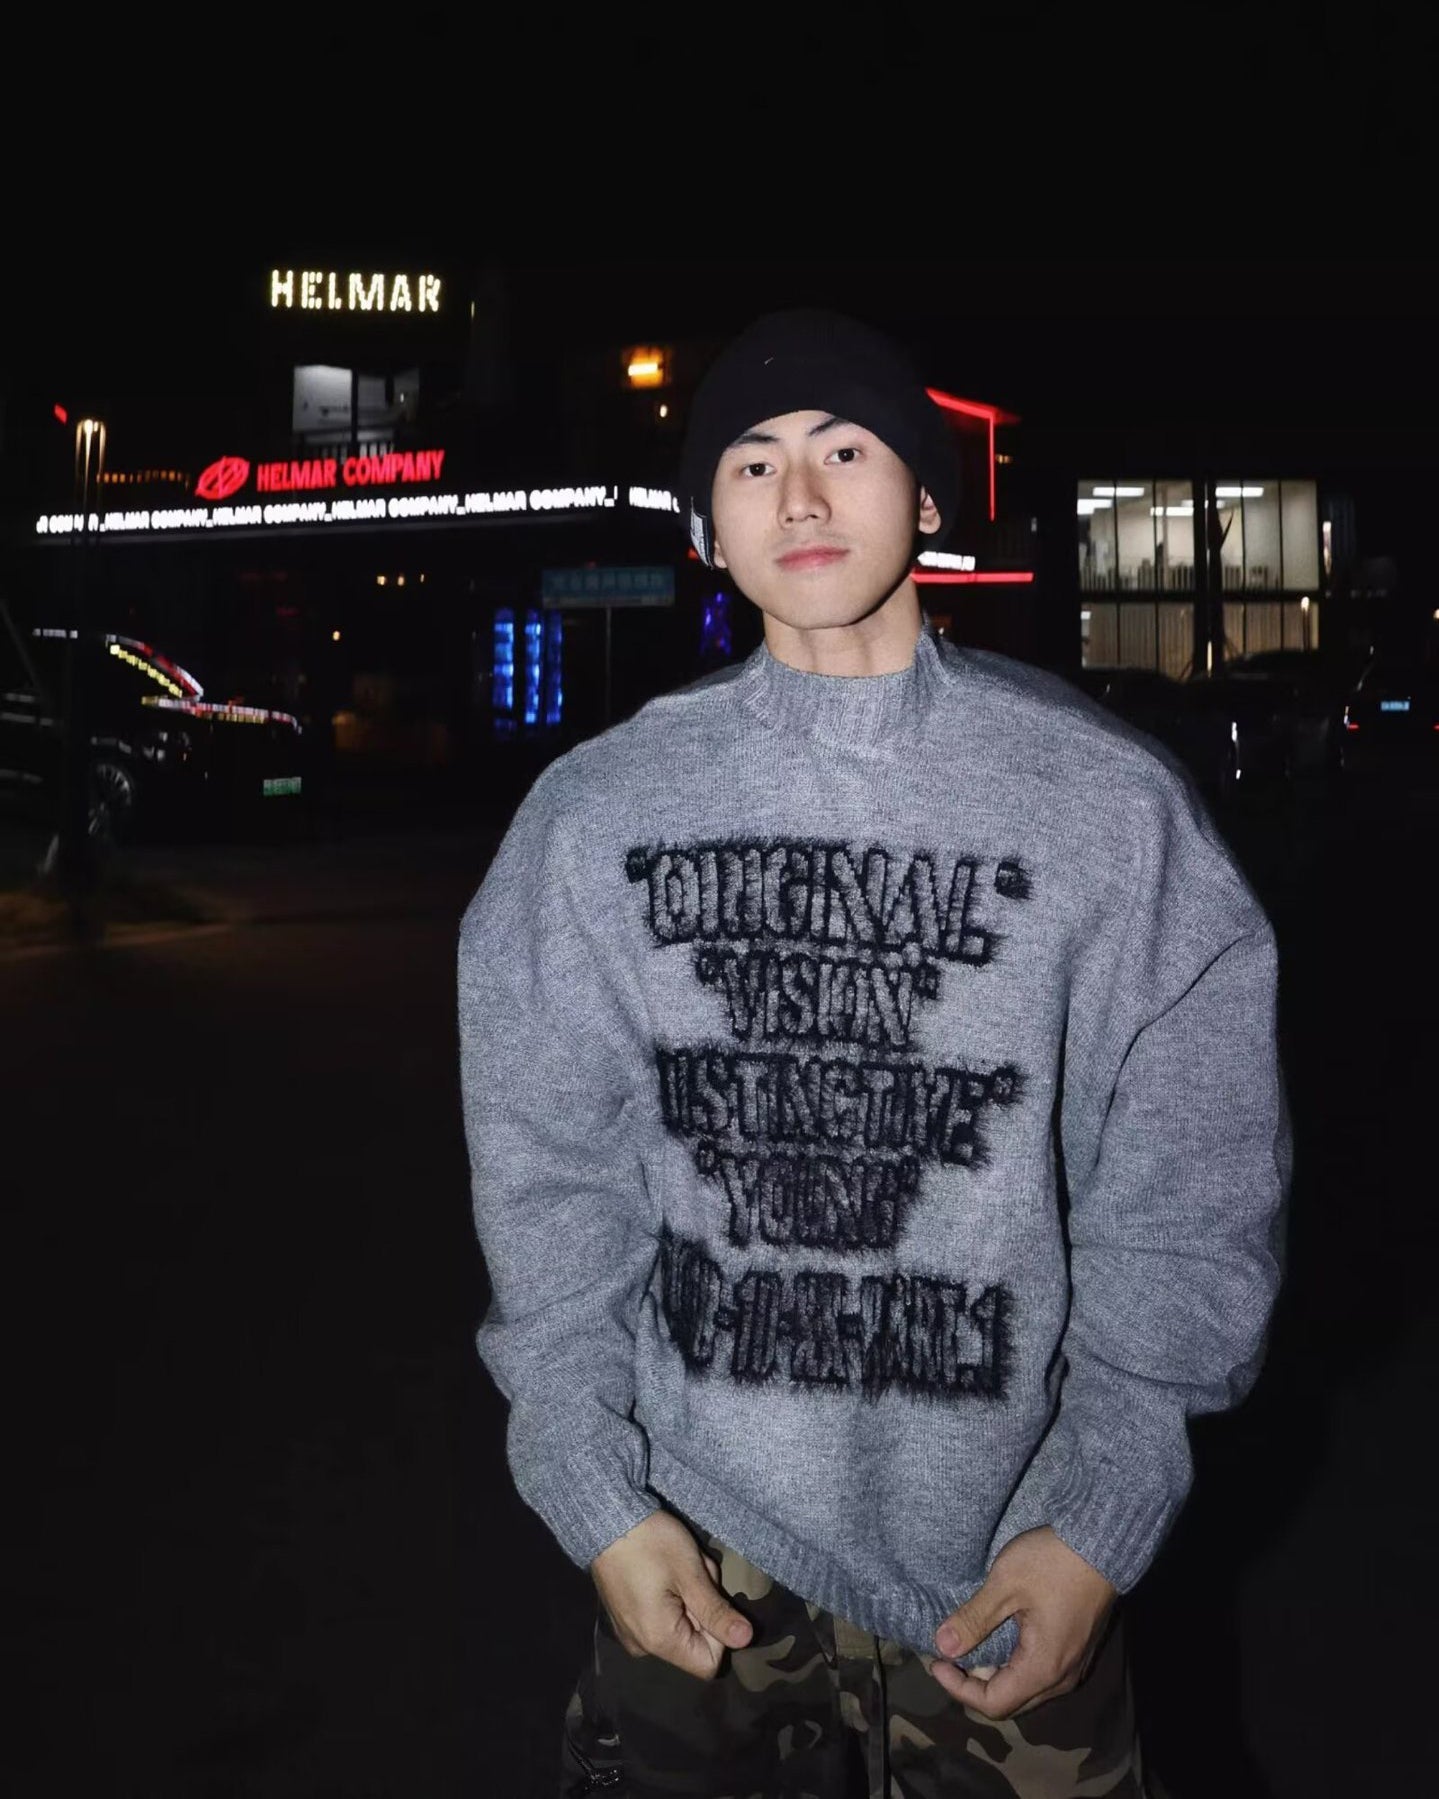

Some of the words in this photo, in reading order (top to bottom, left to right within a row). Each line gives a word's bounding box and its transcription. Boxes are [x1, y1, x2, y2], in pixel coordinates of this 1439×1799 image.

[271, 269, 441, 312] HELMAR
[257, 458, 338, 492] HELMAR
[342, 450, 445, 486] COMPANY
